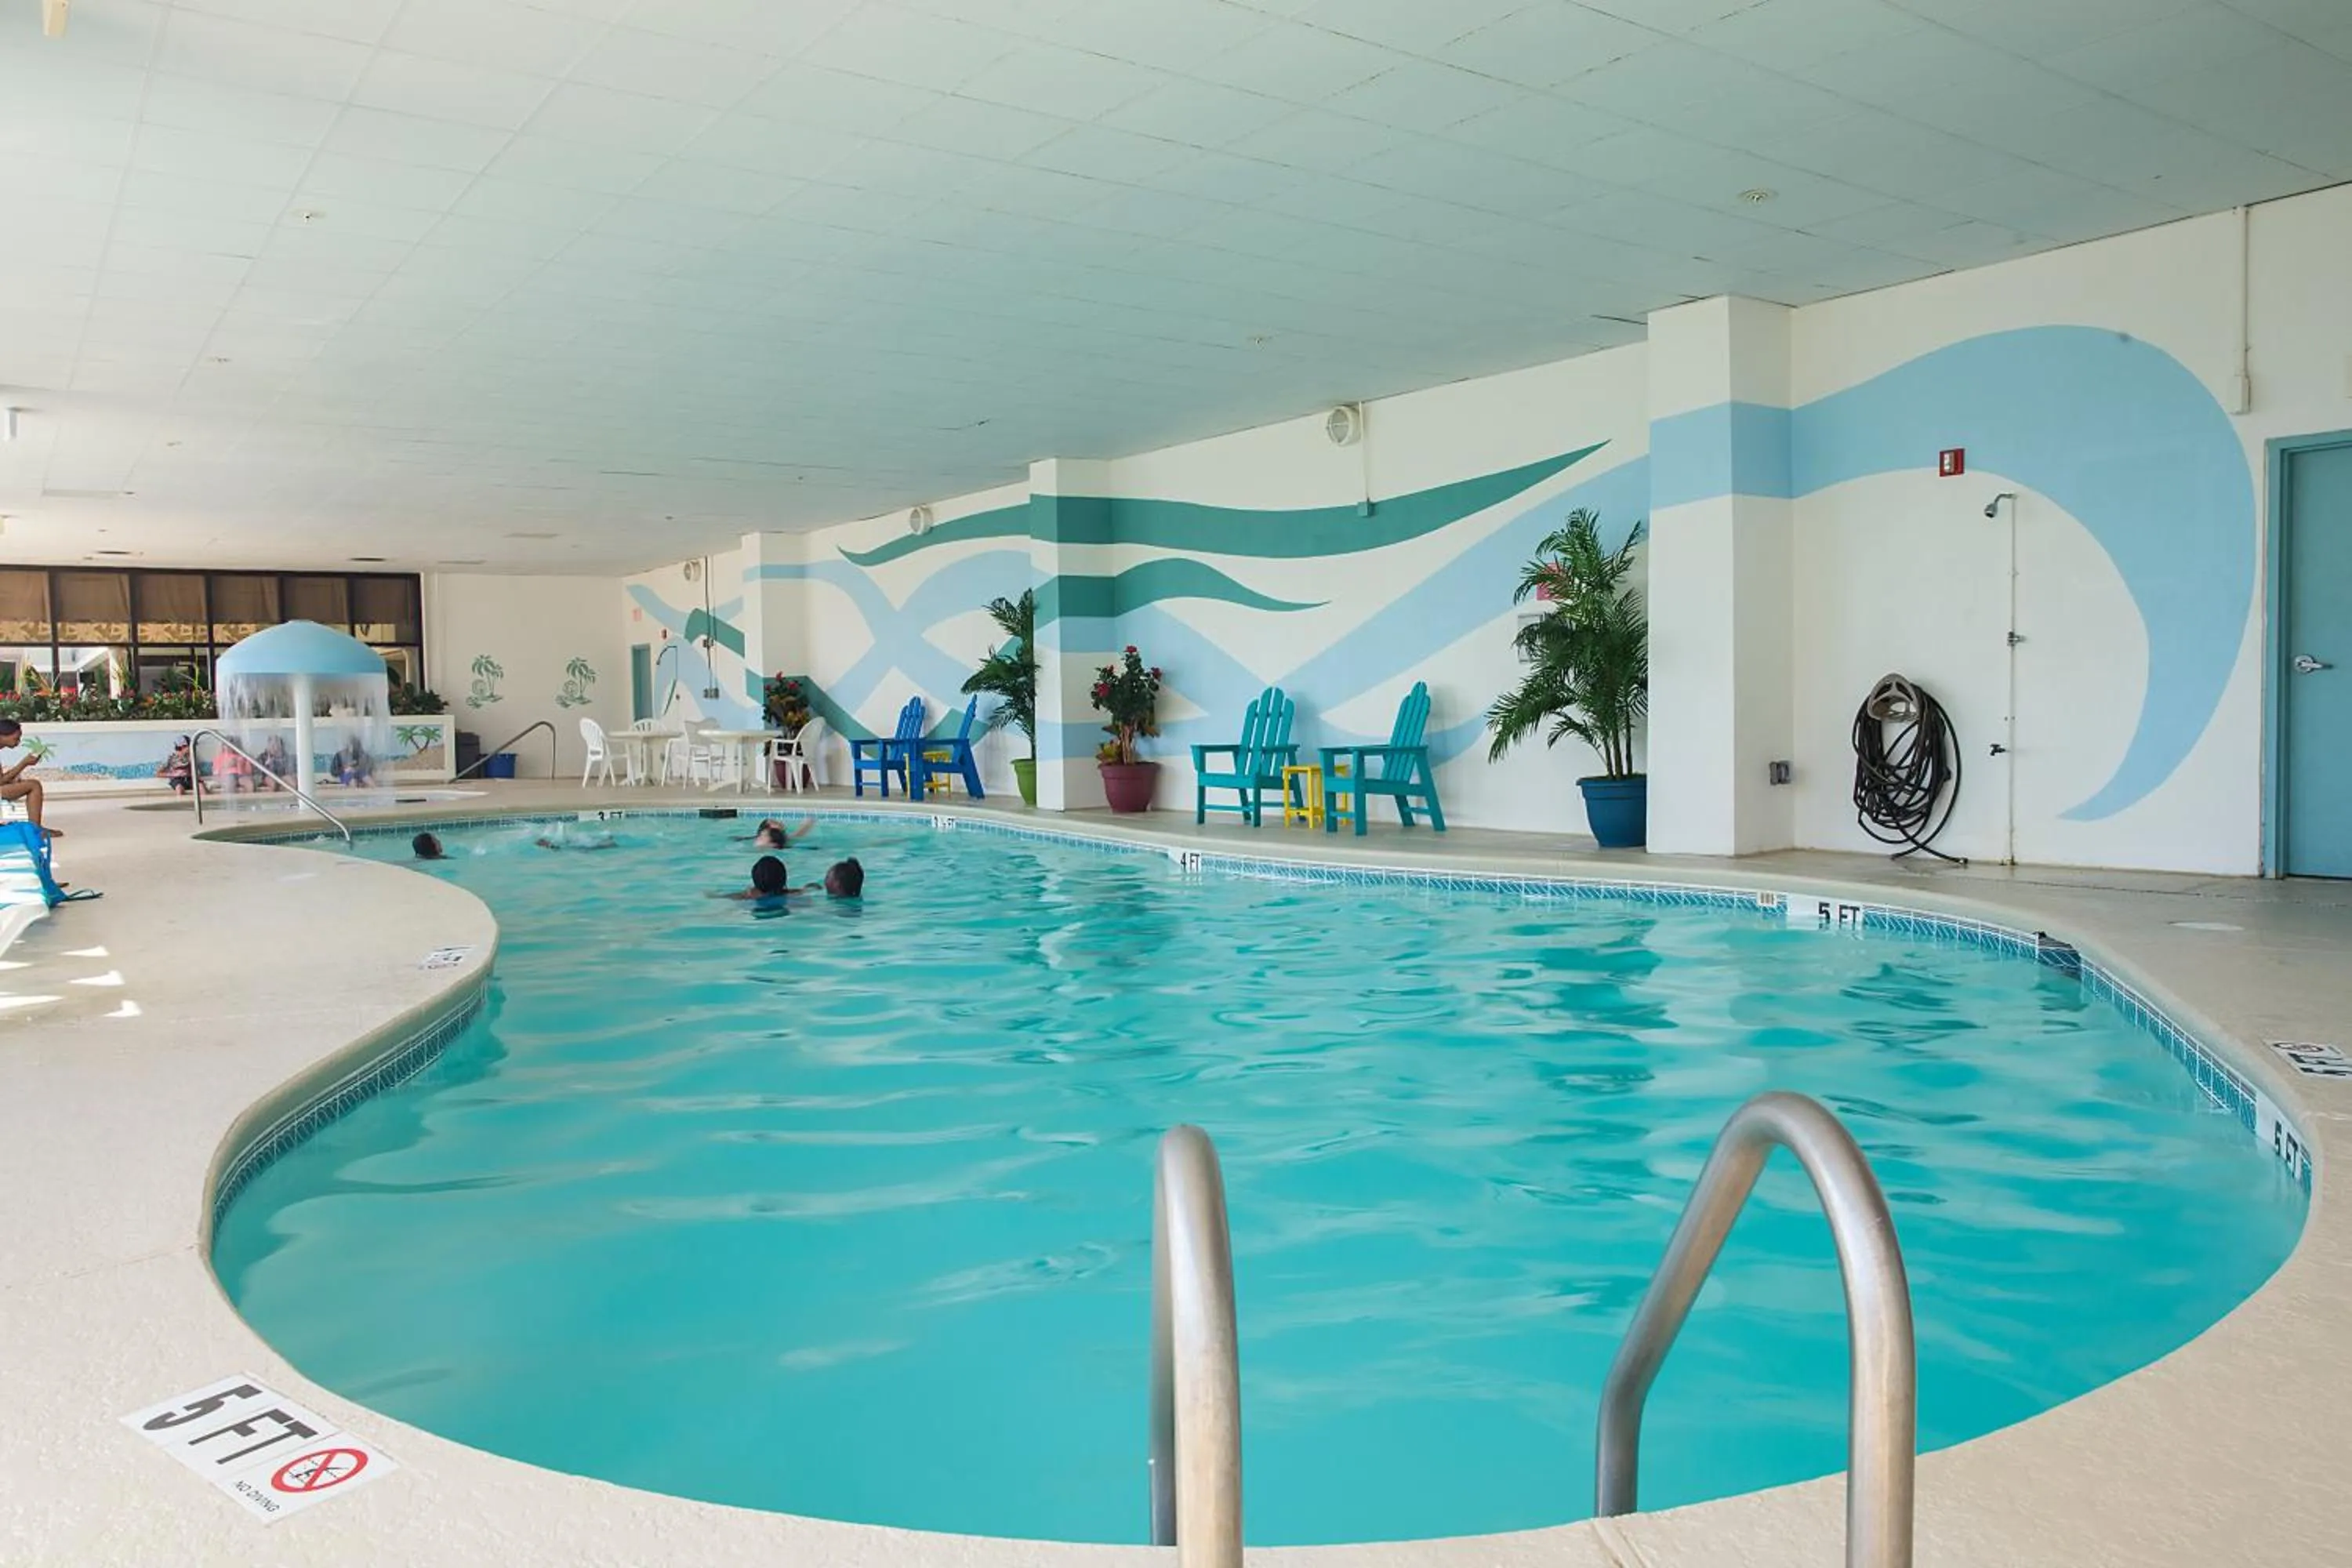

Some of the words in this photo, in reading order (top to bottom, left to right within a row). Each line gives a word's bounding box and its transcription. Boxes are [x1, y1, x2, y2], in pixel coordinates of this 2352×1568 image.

[1180, 852, 1186, 872] 4
[1189, 852, 1200, 872] FT
[1818, 902, 1830, 924] 5
[1838, 904, 1860, 925] FT
[2274, 1120, 2282, 1156] 5
[2285, 1131, 2299, 1178] FT
[143, 1384, 263, 1431] 5
[187, 1408, 318, 1465] FT
[235, 1479, 252, 1493] NO
[245, 1490, 281, 1513] DIVING
